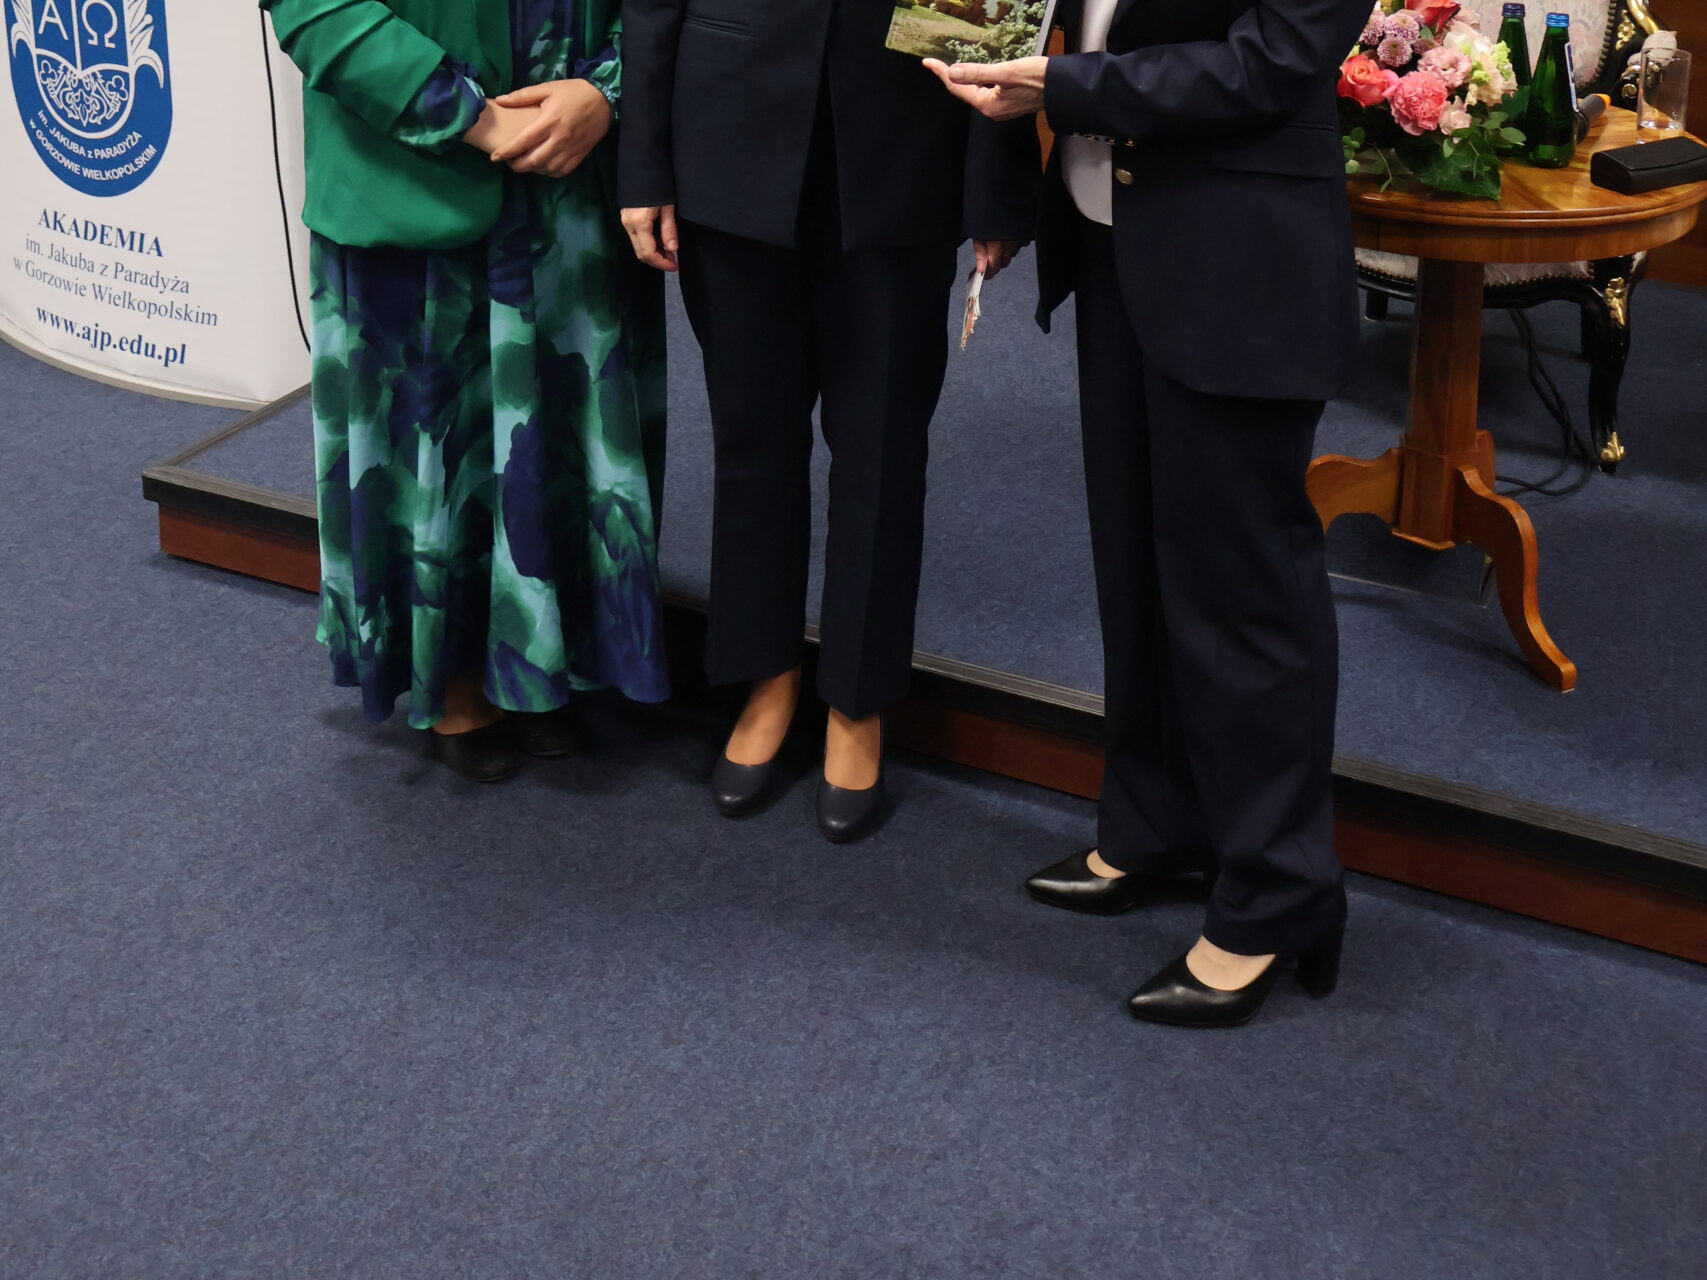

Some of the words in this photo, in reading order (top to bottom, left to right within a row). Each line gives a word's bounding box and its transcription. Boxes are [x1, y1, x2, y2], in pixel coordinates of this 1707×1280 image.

[36, 129, 81, 175] GORZOWIE
[81, 144, 158, 181] WIELKOPOLSKIM
[38, 109, 48, 128] im.
[49, 127, 86, 157] JAKUBA
[94, 130, 143, 159] PARADYŻA
[38, 208, 164, 258] AKADEMIA
[13, 257, 22, 271] w
[25, 259, 87, 297] Gorzowie
[92, 283, 218, 326] Wielkopolskim
[25, 233, 44, 257] im.
[48, 243, 95, 273] Jakuba
[100, 263, 108, 276] z
[114, 262, 190, 294] Paradyża
[36, 307, 187, 368] www.ajp.edu.pl
